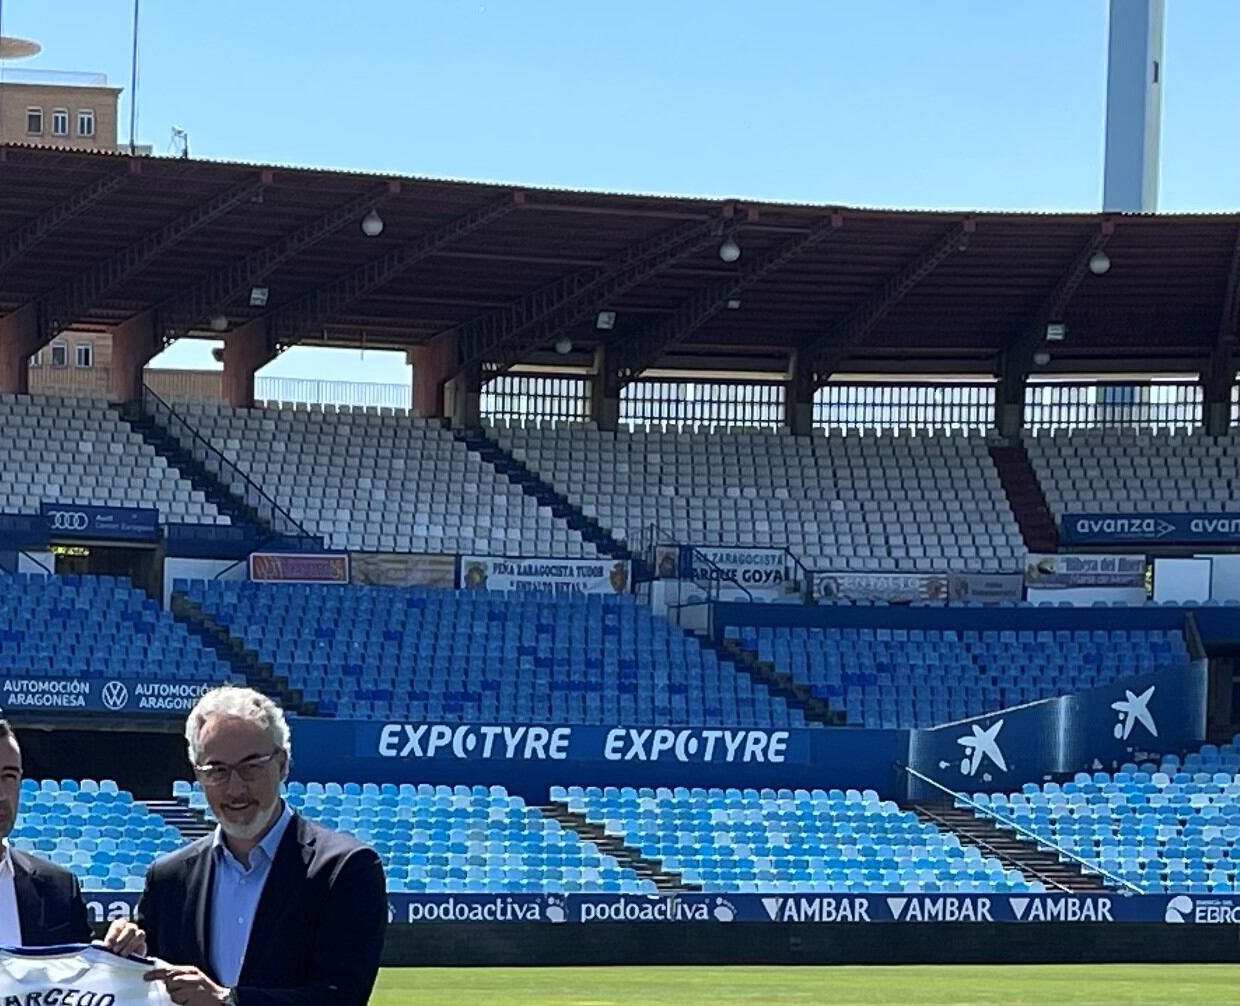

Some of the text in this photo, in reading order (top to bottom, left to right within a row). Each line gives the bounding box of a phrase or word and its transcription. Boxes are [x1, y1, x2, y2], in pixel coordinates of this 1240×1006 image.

[1076, 518, 1155, 533] avanza
[1190, 518, 1240, 533] avan
[492, 559, 515, 576] PEÑA
[692, 567, 783, 584] ARQUE GOYA
[3, 679, 90, 695] AUTOMOCIÓN
[135, 682, 213, 697] AUTOMOCIÓ
[7, 693, 86, 707] ARAGONESA
[378, 724, 572, 759] EXPOTYRE
[604, 727, 790, 763] EXPOTYRE
[407, 897, 541, 923] podoactiva
[580, 897, 710, 923] podoactiva
[782, 897, 872, 922] AMBAR
[905, 897, 995, 922] AMBAR
[1027, 897, 1115, 922] AMBAR
